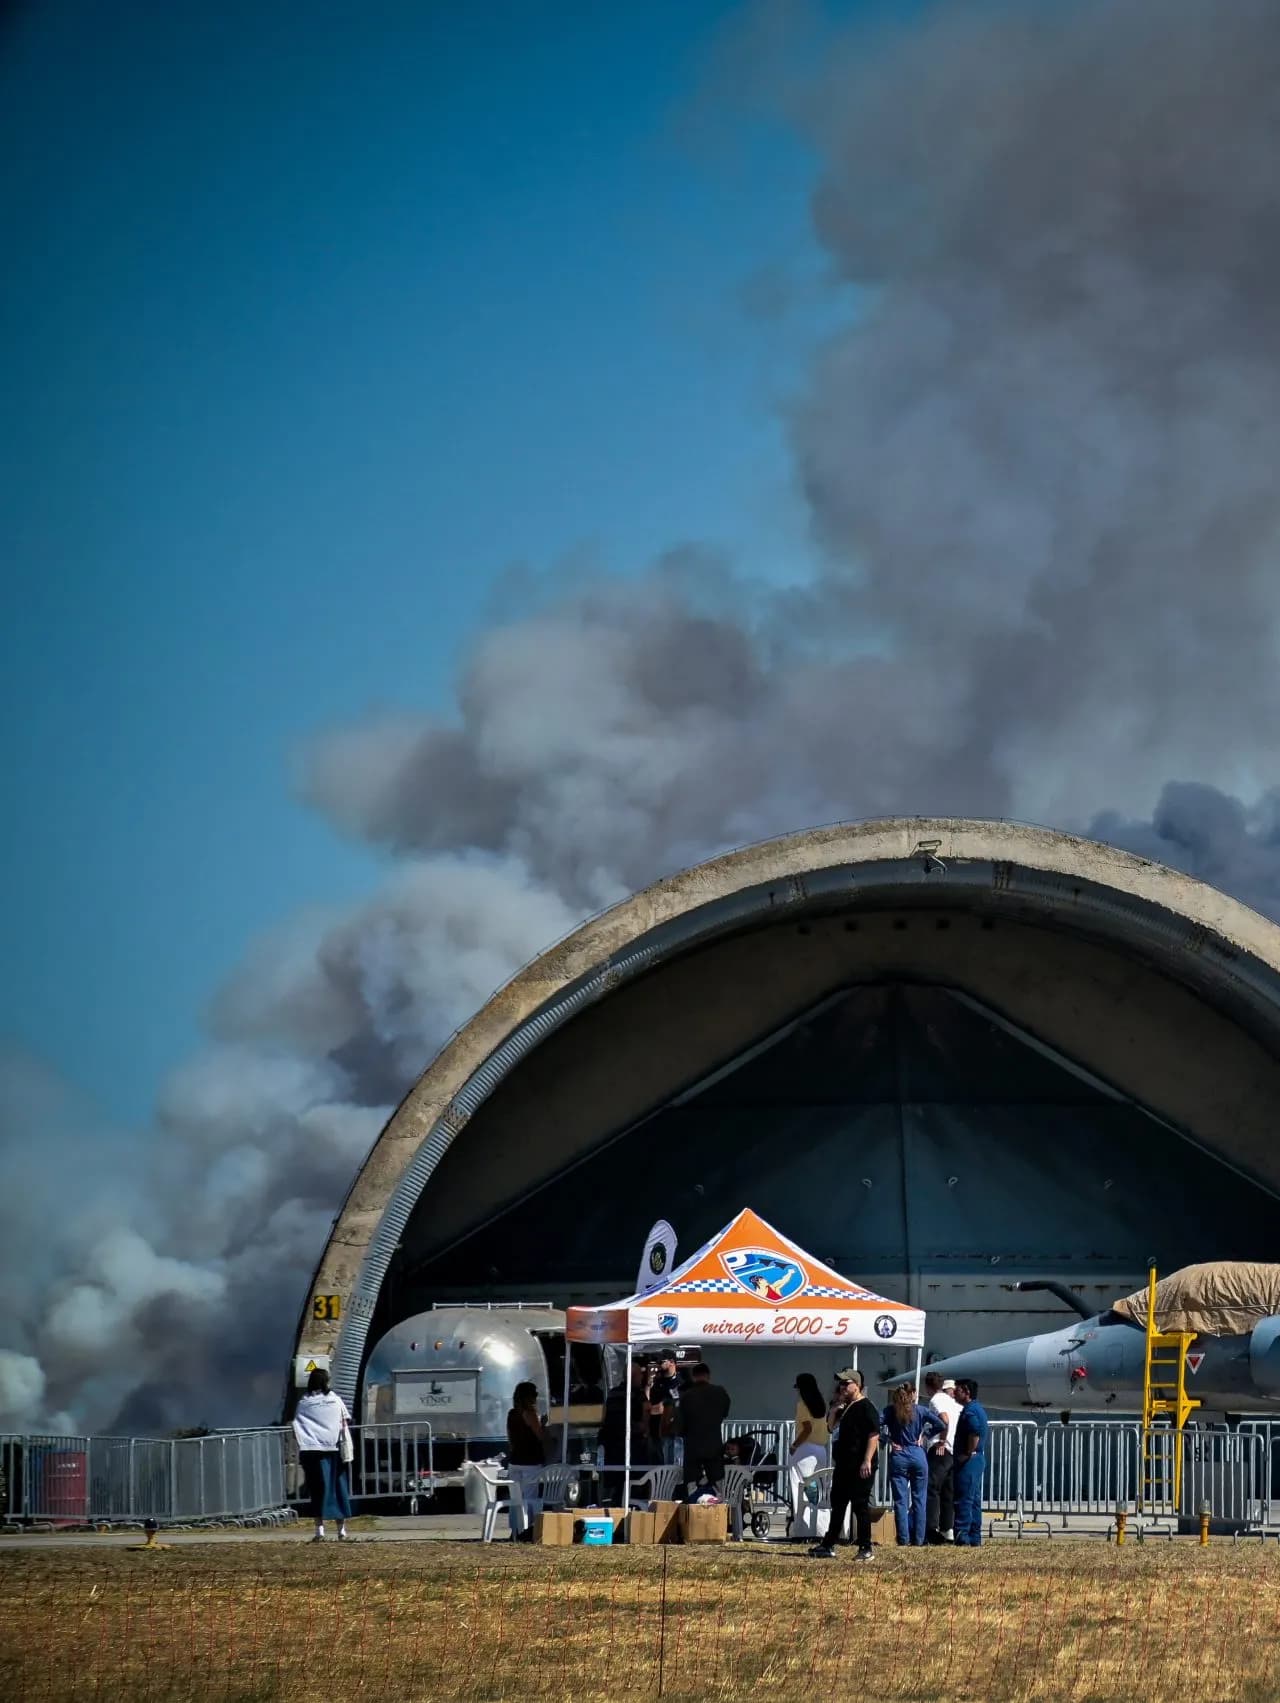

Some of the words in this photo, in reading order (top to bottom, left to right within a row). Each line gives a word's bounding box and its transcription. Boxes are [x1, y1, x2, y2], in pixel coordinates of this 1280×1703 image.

[314, 1295, 340, 1319] 31
[702, 1319, 765, 1342] mirage
[771, 1316, 850, 1336] 2000-5
